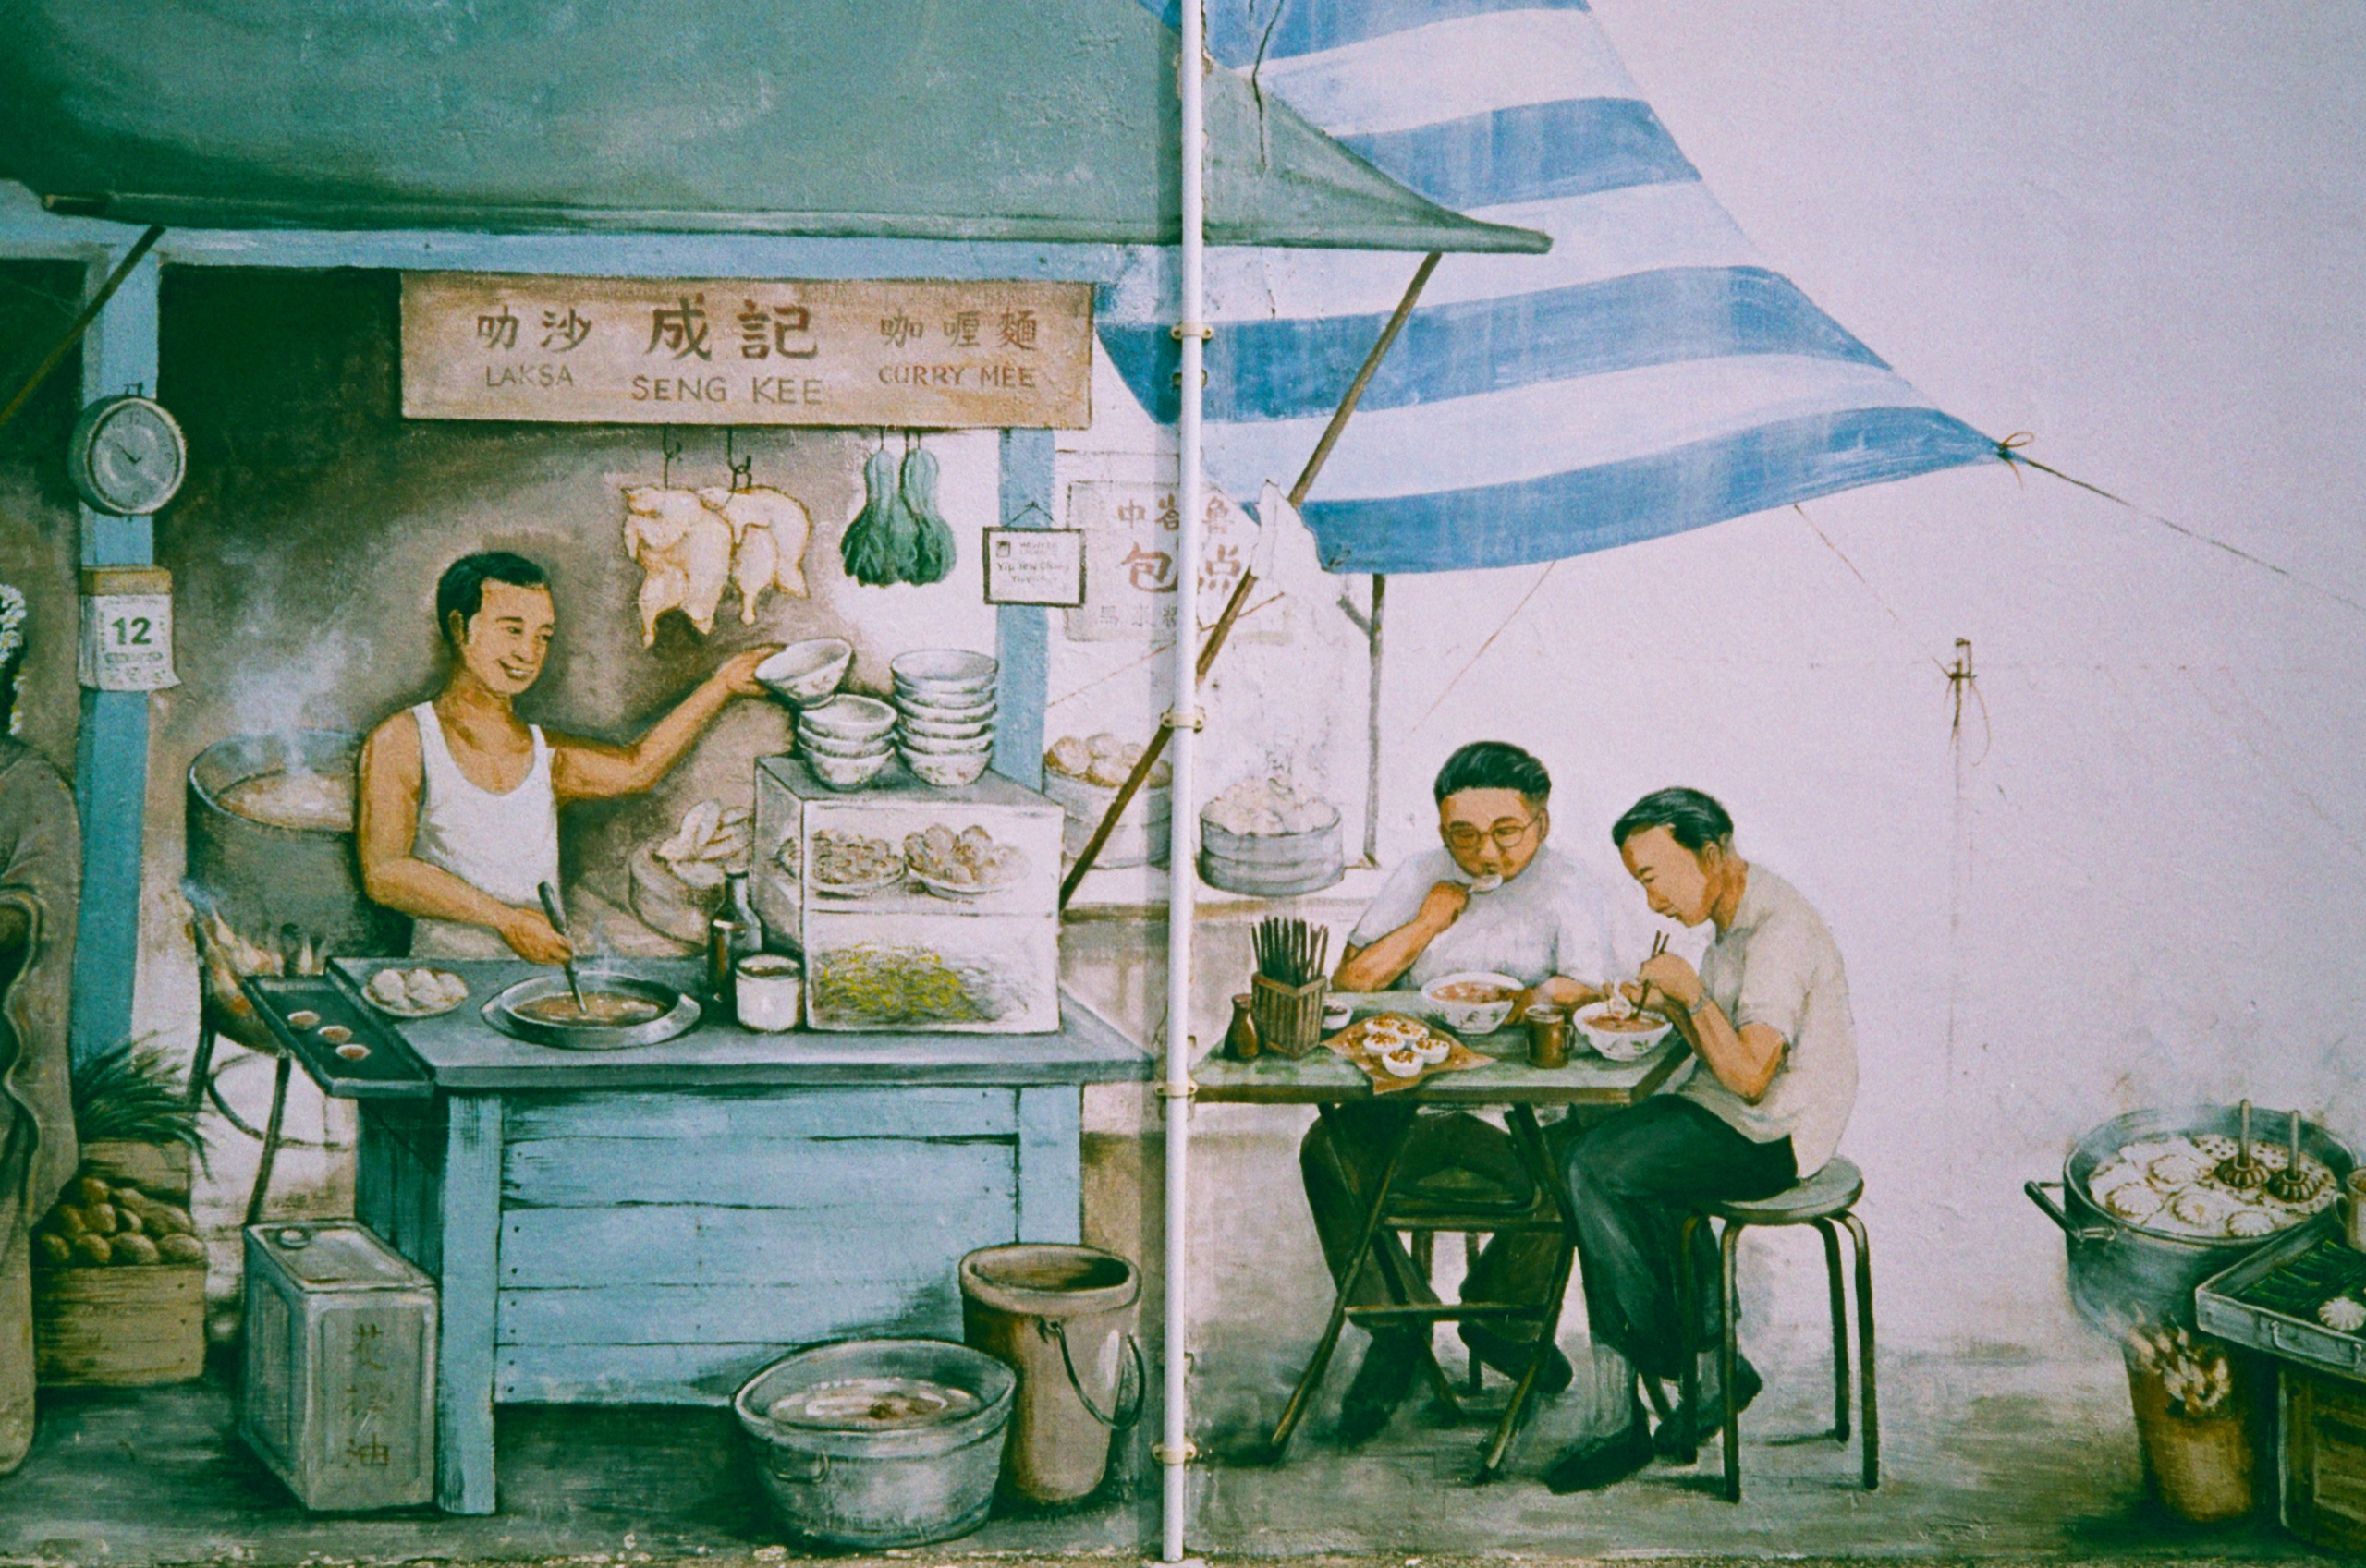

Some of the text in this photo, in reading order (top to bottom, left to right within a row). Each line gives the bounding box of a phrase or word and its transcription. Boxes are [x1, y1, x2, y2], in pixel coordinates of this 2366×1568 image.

[475, 305, 592, 353] 叻沙
[645, 292, 819, 361] 成記
[879, 310, 1038, 351] 咖喱麵
[485, 365, 574, 388] LAKSA
[631, 374, 823, 406] SENG KEE
[878, 364, 1037, 388] CURRY MEE
[111, 616, 152, 645] 12
